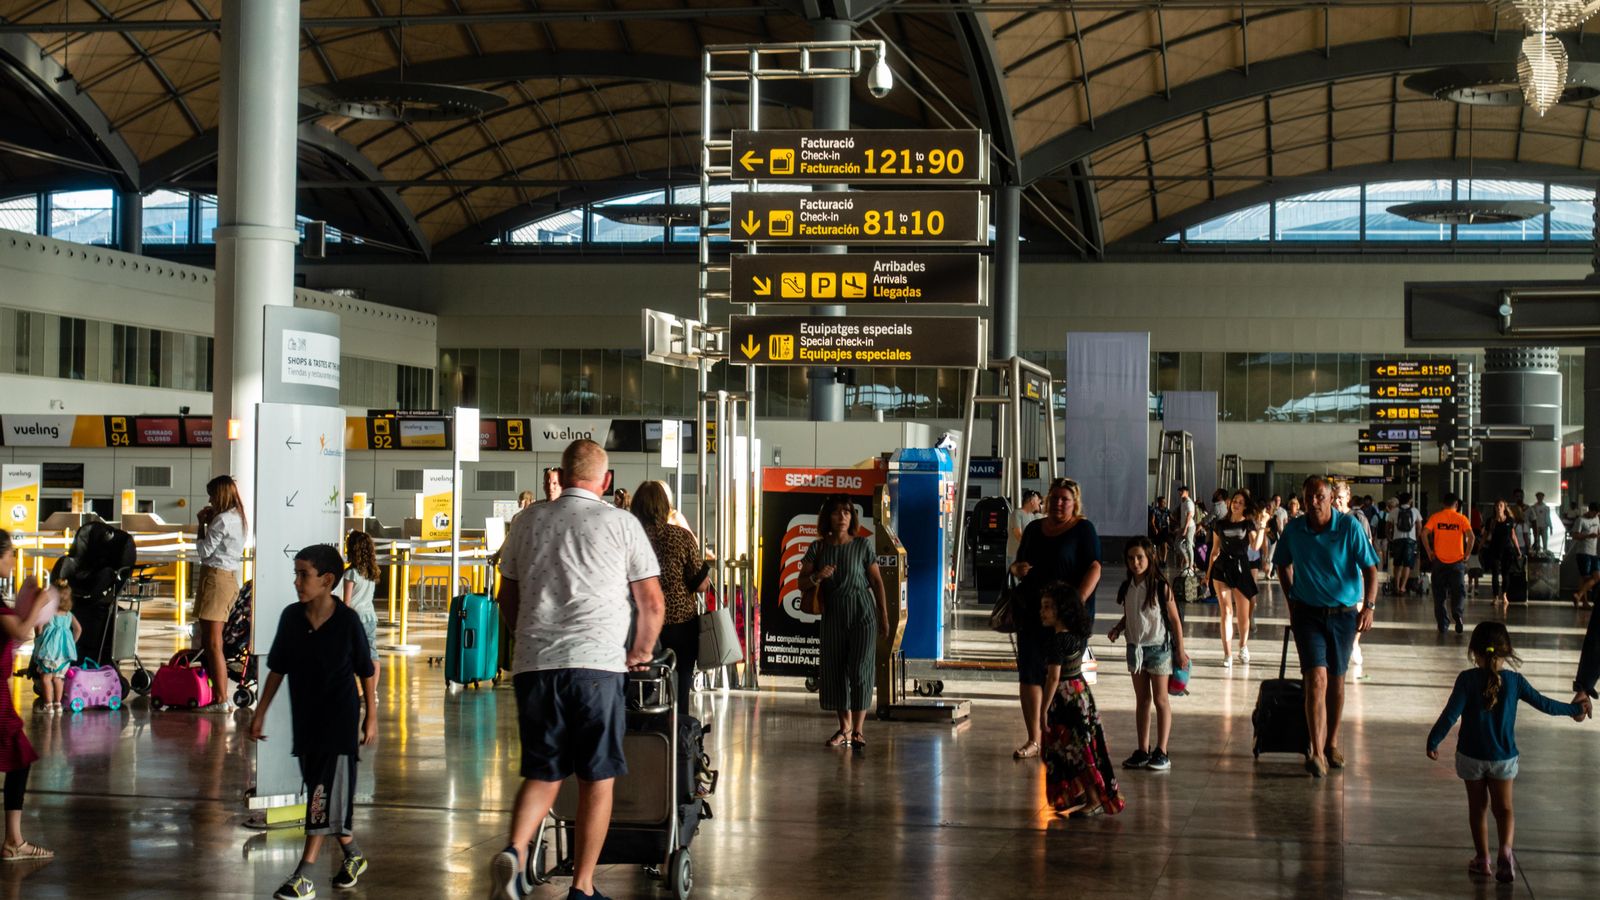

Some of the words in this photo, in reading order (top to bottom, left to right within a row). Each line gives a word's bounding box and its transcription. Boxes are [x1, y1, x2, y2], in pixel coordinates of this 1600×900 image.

[801, 137, 854, 149] Facturació
[801, 150, 840, 160] Check-in
[864, 149, 913, 174] 121
[916, 152, 925, 161] to
[928, 149, 964, 174] 90
[800, 162, 860, 174] Facturación
[916, 164, 924, 174] a
[800, 198, 853, 210] Facturació
[800, 211, 839, 222] Check-in
[864, 210, 896, 235] 81
[899, 213, 908, 222] to
[911, 210, 944, 235] 10
[799, 223, 859, 235] Facturación
[900, 225, 907, 235] a
[873, 260, 926, 272] Arribades
[873, 274, 908, 284] Arrivals
[873, 286, 922, 299] Llegadas
[800, 322, 859, 335] Equipatges
[863, 322, 912, 335] especials
[800, 335, 833, 347] Special
[835, 335, 874, 347] check-in
[800, 347, 853, 361] Equipajes
[855, 347, 912, 361] especiales
[288, 357, 307, 366] SHOPS
[1421, 365, 1434, 375] 81
[1438, 365, 1452, 375] 50
[1421, 386, 1434, 396] 41
[1438, 386, 1452, 396] 10
[14, 422, 60, 438] vueling
[111, 433, 130, 446] 94
[374, 435, 393, 449] 92
[508, 437, 525, 450] 91
[8, 469, 32, 478] vueling
[969, 465, 995, 473] NAIR
[429, 475, 454, 483] vueling
[785, 473, 834, 488] SECURE
[836, 475, 863, 488] BAG
[799, 527, 818, 535] Protec
[766, 632, 776, 642] Las
[776, 635, 806, 645] compañías
[806, 634, 820, 645] aéro
[764, 645, 799, 654] recomiendan
[800, 646, 820, 656] precint
[775, 654, 820, 666] EQUIPAJE
